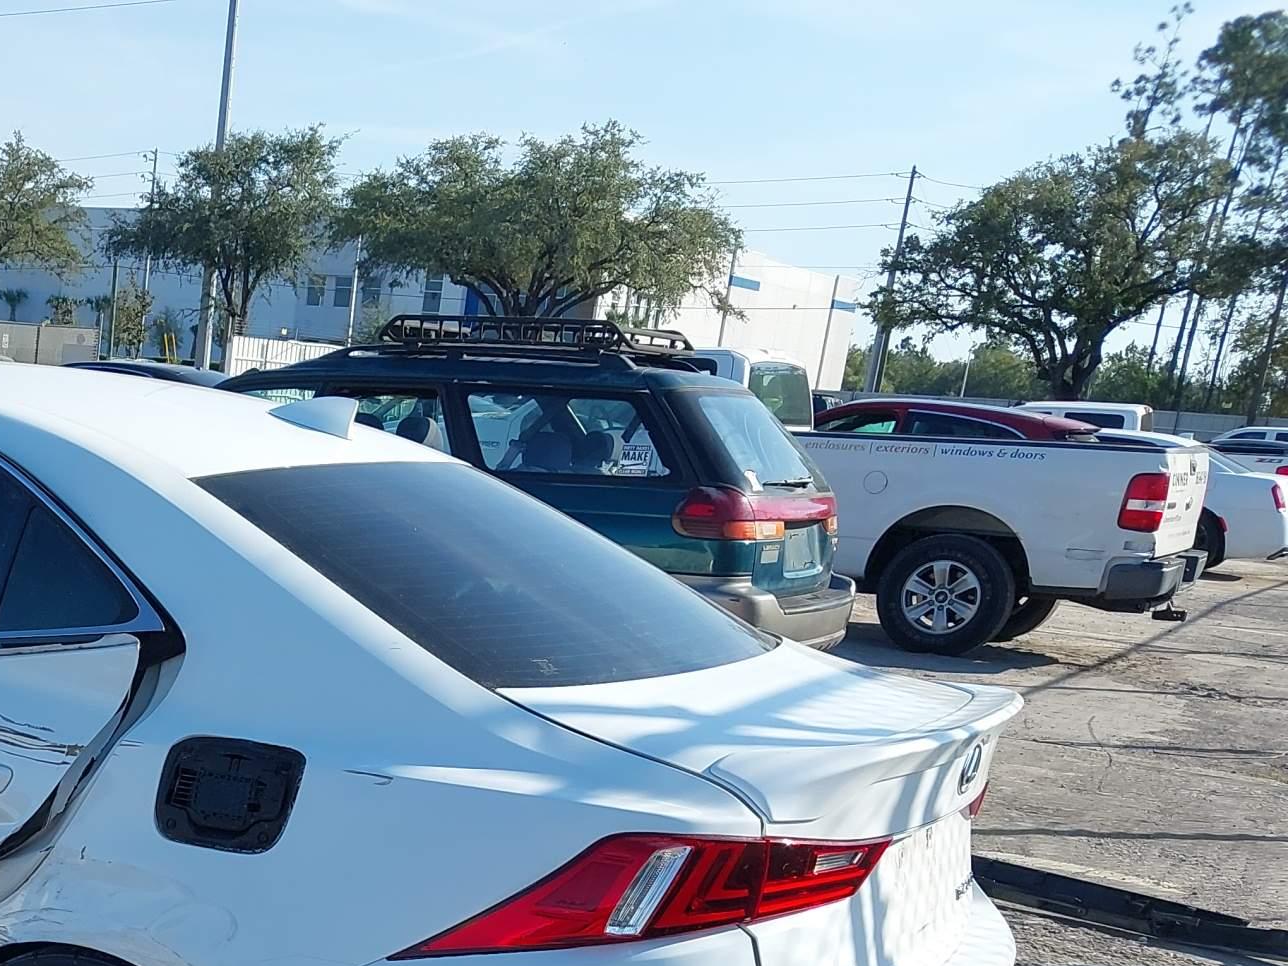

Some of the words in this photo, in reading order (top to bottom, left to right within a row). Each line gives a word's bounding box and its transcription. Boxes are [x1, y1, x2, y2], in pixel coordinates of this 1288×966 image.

[621, 452, 649, 461] MAKE
[805, 440, 865, 452] enclosures
[876, 444, 929, 455] exteriors
[941, 446, 993, 458] windows
[997, 448, 1008, 458] &
[1010, 448, 1047, 460] doors
